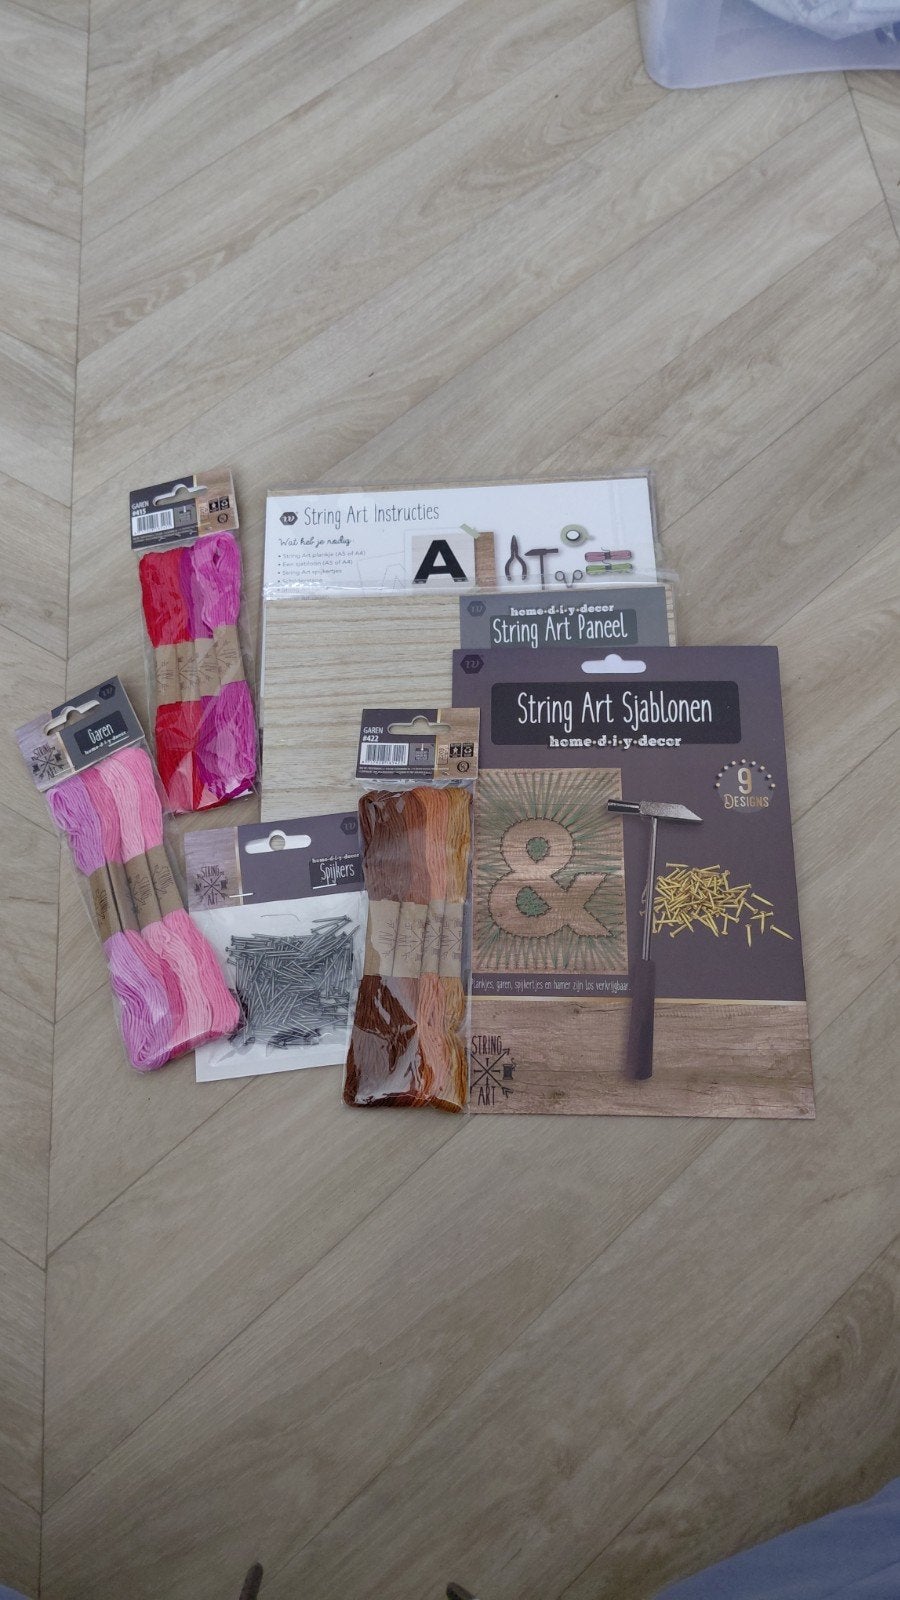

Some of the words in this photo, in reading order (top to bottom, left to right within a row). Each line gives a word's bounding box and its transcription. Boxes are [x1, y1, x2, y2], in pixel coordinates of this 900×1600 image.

[131, 500, 150, 511] GAREN
[304, 506, 341, 530] String
[347, 505, 368, 524] Art
[374, 502, 440, 523] Instructies
[279, 538, 298, 547] Wat
[300, 536, 315, 546] heb
[315, 539, 326, 548] je
[326, 534, 352, 547] nodig
[412, 539, 468, 585] A
[492, 618, 538, 649] String
[545, 615, 572, 642] Art
[578, 612, 628, 640] Paneel
[517, 692, 573, 733] String
[581, 691, 614, 724] Art
[622, 690, 713, 732] Sjablonen
[87, 723, 115, 745] Garen
[362, 734, 379, 742] #422
[363, 726, 384, 735] GAREN
[736, 767, 753, 794] 9
[723, 794, 769, 809] DESIGNS
[319, 861, 355, 886] Spijkers
[472, 1035, 503, 1055] STRING
[478, 1086, 496, 1106] ART
